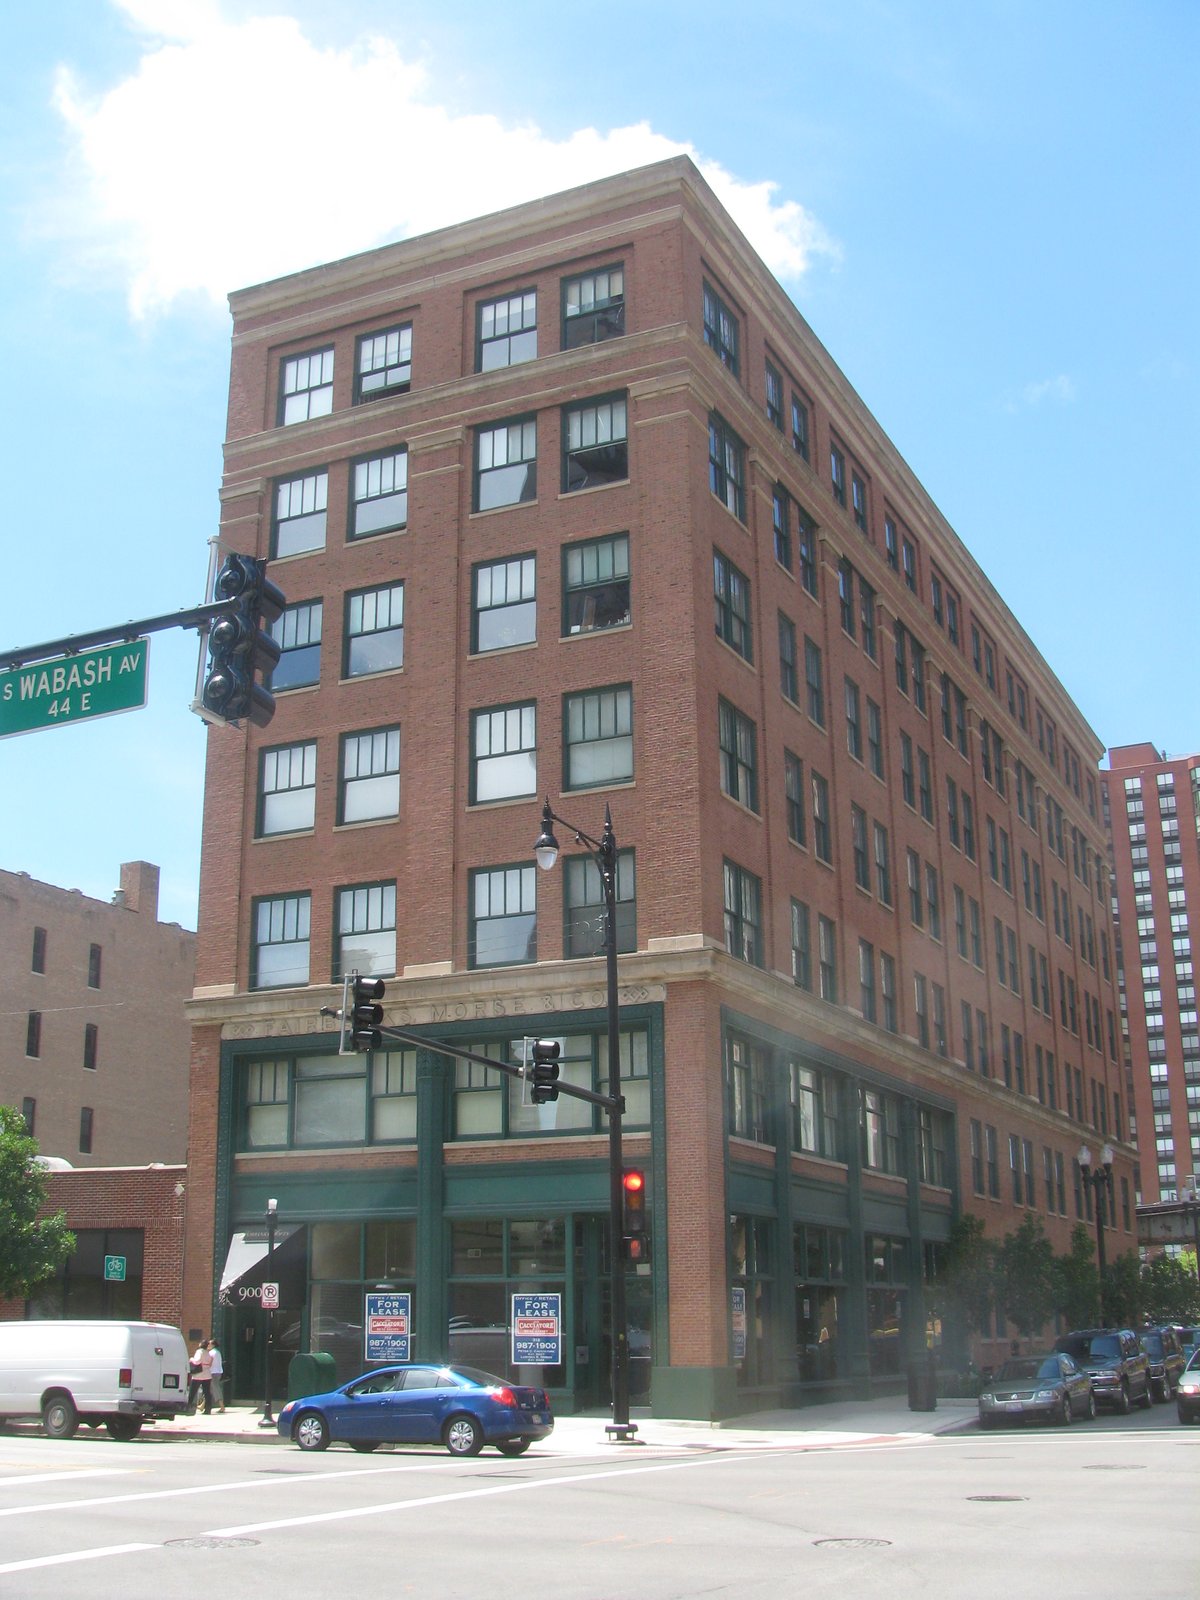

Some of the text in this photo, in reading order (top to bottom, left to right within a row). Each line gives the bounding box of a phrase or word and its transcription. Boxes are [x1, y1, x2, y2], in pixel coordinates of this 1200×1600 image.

[3, 653, 141, 701] S WABASH AV
[48, 692, 92, 717] 44 E
[541, 993, 556, 1012] &
[239, 1287, 262, 1301] 900
[377, 1300, 399, 1308] FOR
[525, 1301, 549, 1309] FOR
[517, 1309, 556, 1317] LEASE
